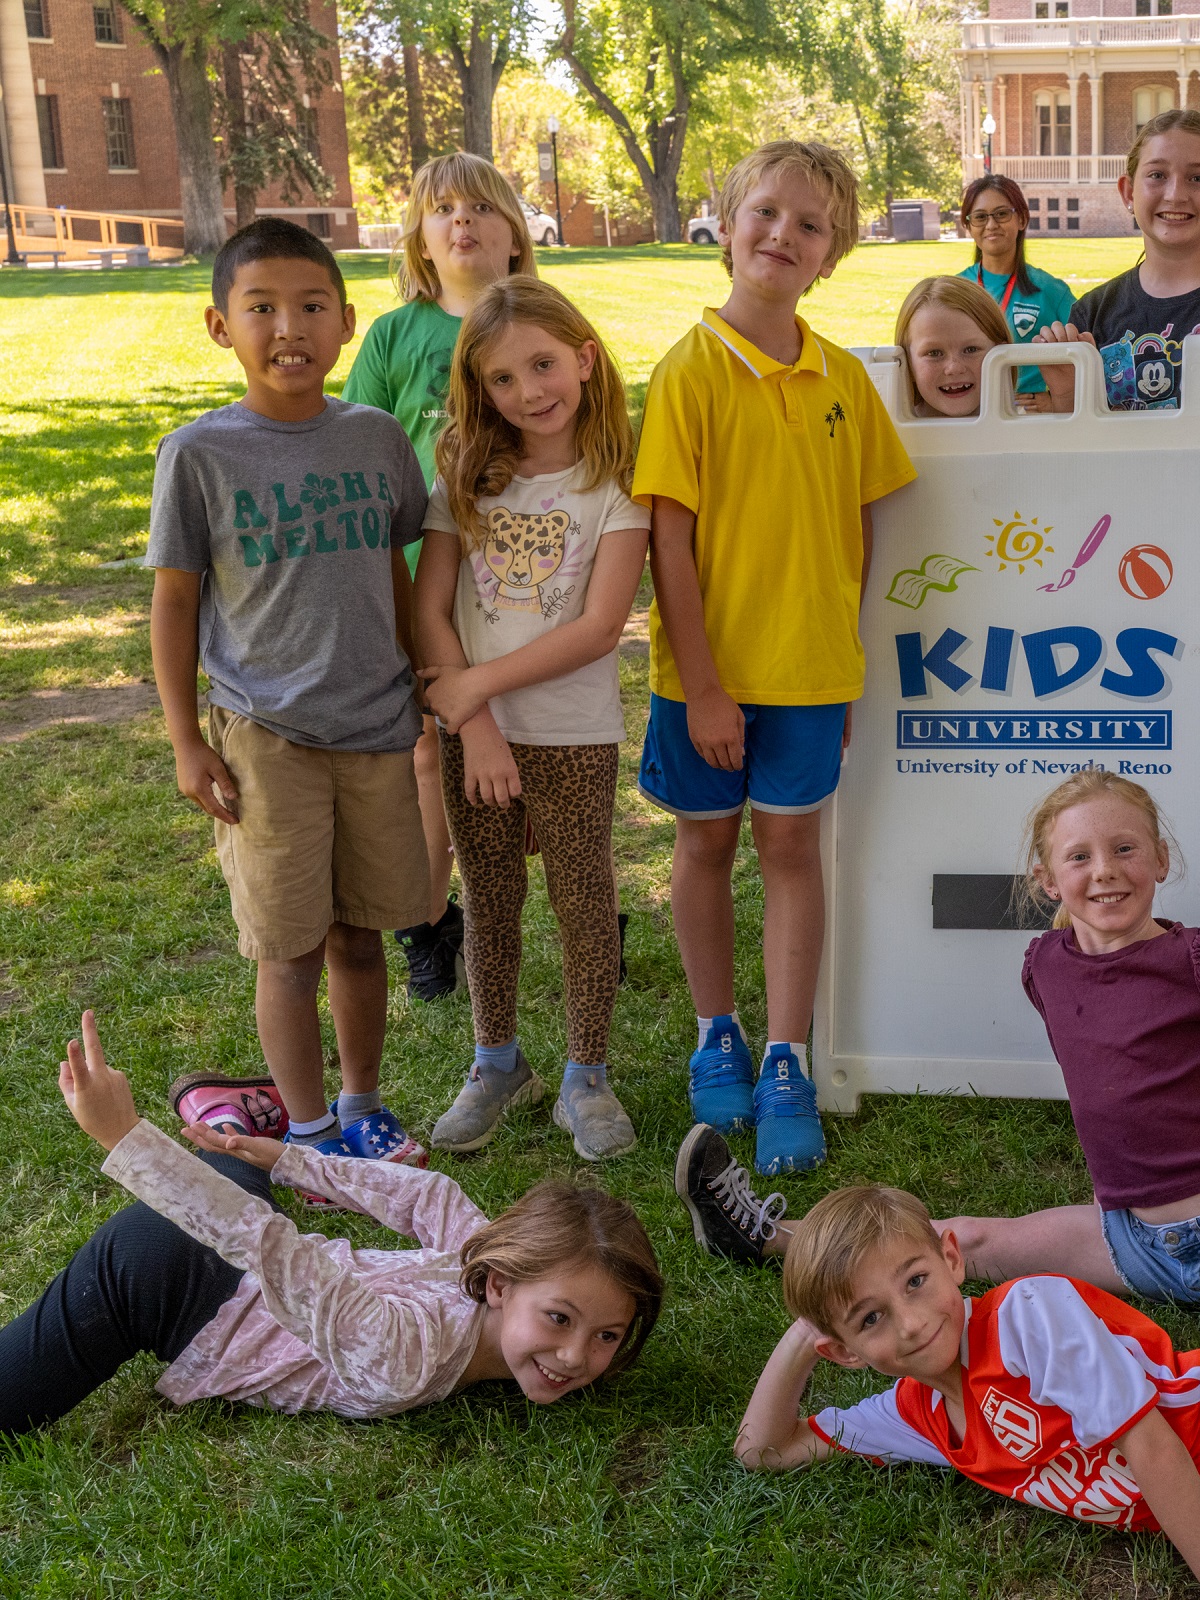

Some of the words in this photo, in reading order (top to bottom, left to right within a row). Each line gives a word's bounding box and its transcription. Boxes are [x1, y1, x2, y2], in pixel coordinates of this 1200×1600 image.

[422, 409, 451, 418] UND
[895, 626, 1184, 701] KIDS
[911, 720, 1157, 740] UNIVERSITY
[896, 759, 1001, 778] University
[1005, 759, 1029, 774] of
[1118, 760, 1172, 775] Reno
